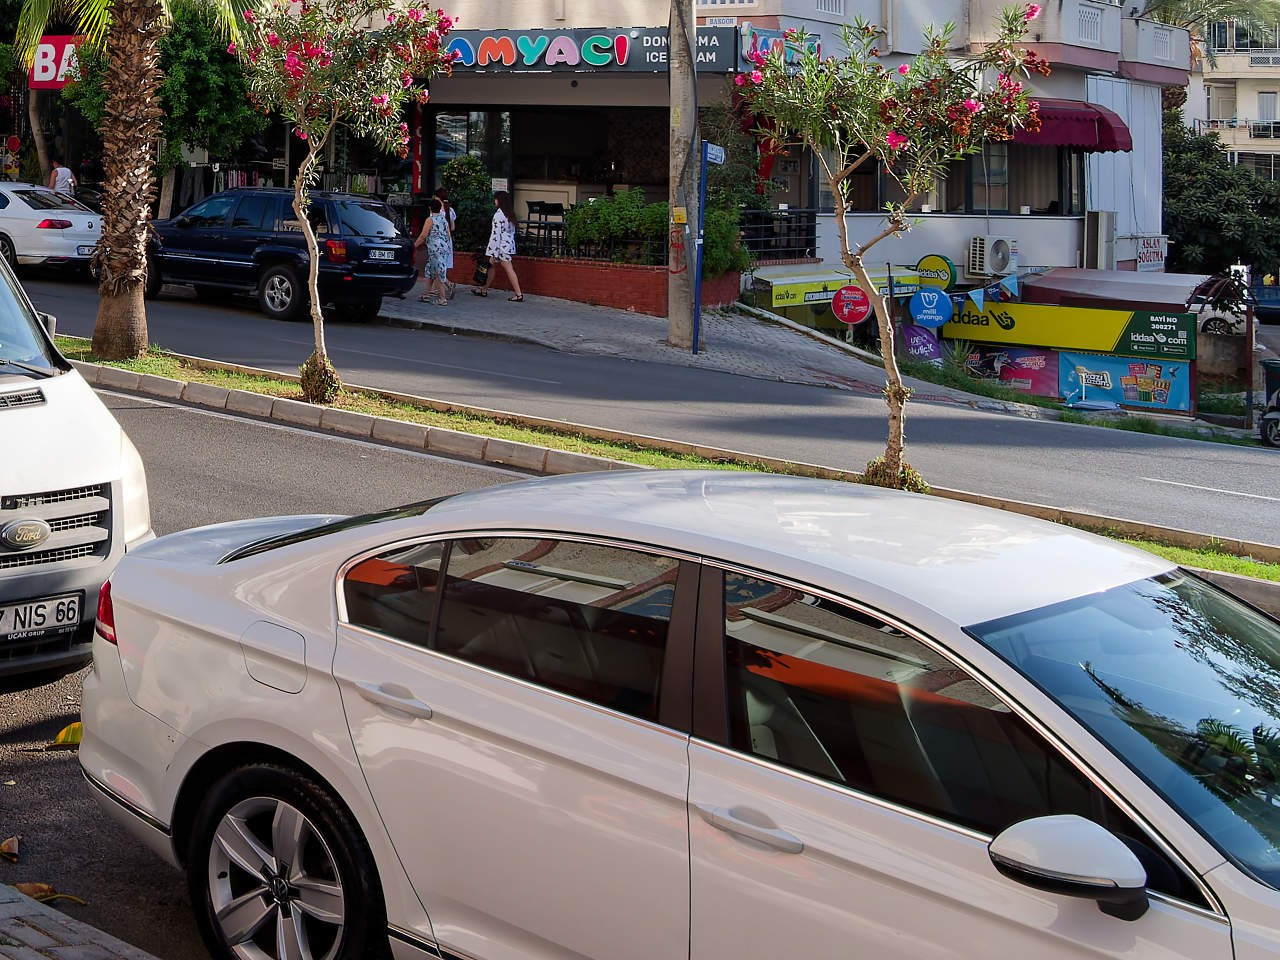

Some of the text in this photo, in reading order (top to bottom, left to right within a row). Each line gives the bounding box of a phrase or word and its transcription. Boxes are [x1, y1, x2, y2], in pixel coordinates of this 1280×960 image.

[643, 35, 720, 47] DONMA
[447, 34, 630, 66] AMYACI
[646, 51, 667, 62] ICE
[1142, 238, 1160, 249] ASLAN
[916, 314, 943, 322] piyango
[950, 310, 989, 326] ddaa
[1130, 332, 1155, 343] iddaa
[15, 525, 41, 542] Ford
[13, 604, 47, 630] NIS
[56, 600, 77, 622] 66
